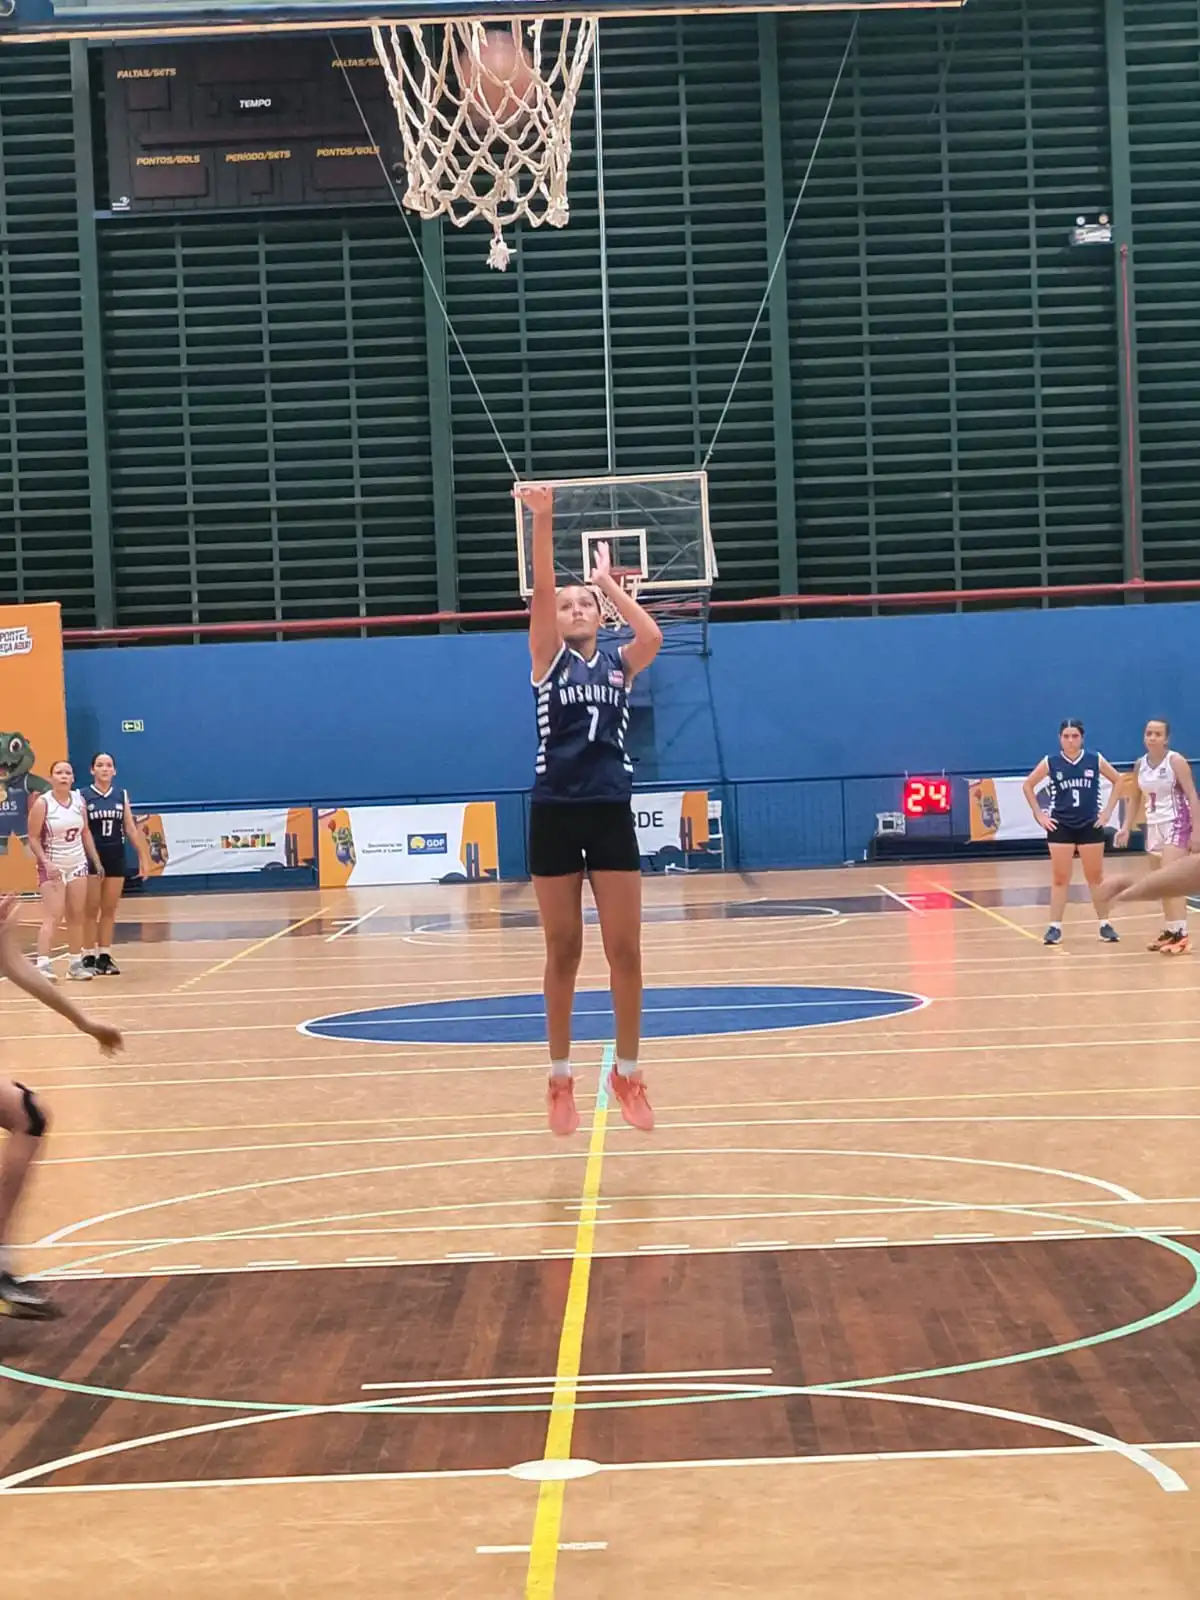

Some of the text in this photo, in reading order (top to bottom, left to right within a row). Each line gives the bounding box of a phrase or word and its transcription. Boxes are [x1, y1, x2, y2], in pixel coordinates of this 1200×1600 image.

[116, 68, 177, 79] FALTAS/SETS
[239, 98, 272, 109] TEMPO
[316, 145, 381, 158] PONTOS/GOLS
[136, 154, 201, 166] PONTOS/GOLS
[559, 683, 620, 707] BASQUETE
[587, 705, 599, 742] 7
[907, 782, 947, 812] 24
[101, 819, 113, 837] 13
[220, 833, 276, 849] BRASIL
[426, 838, 445, 847] GDF
